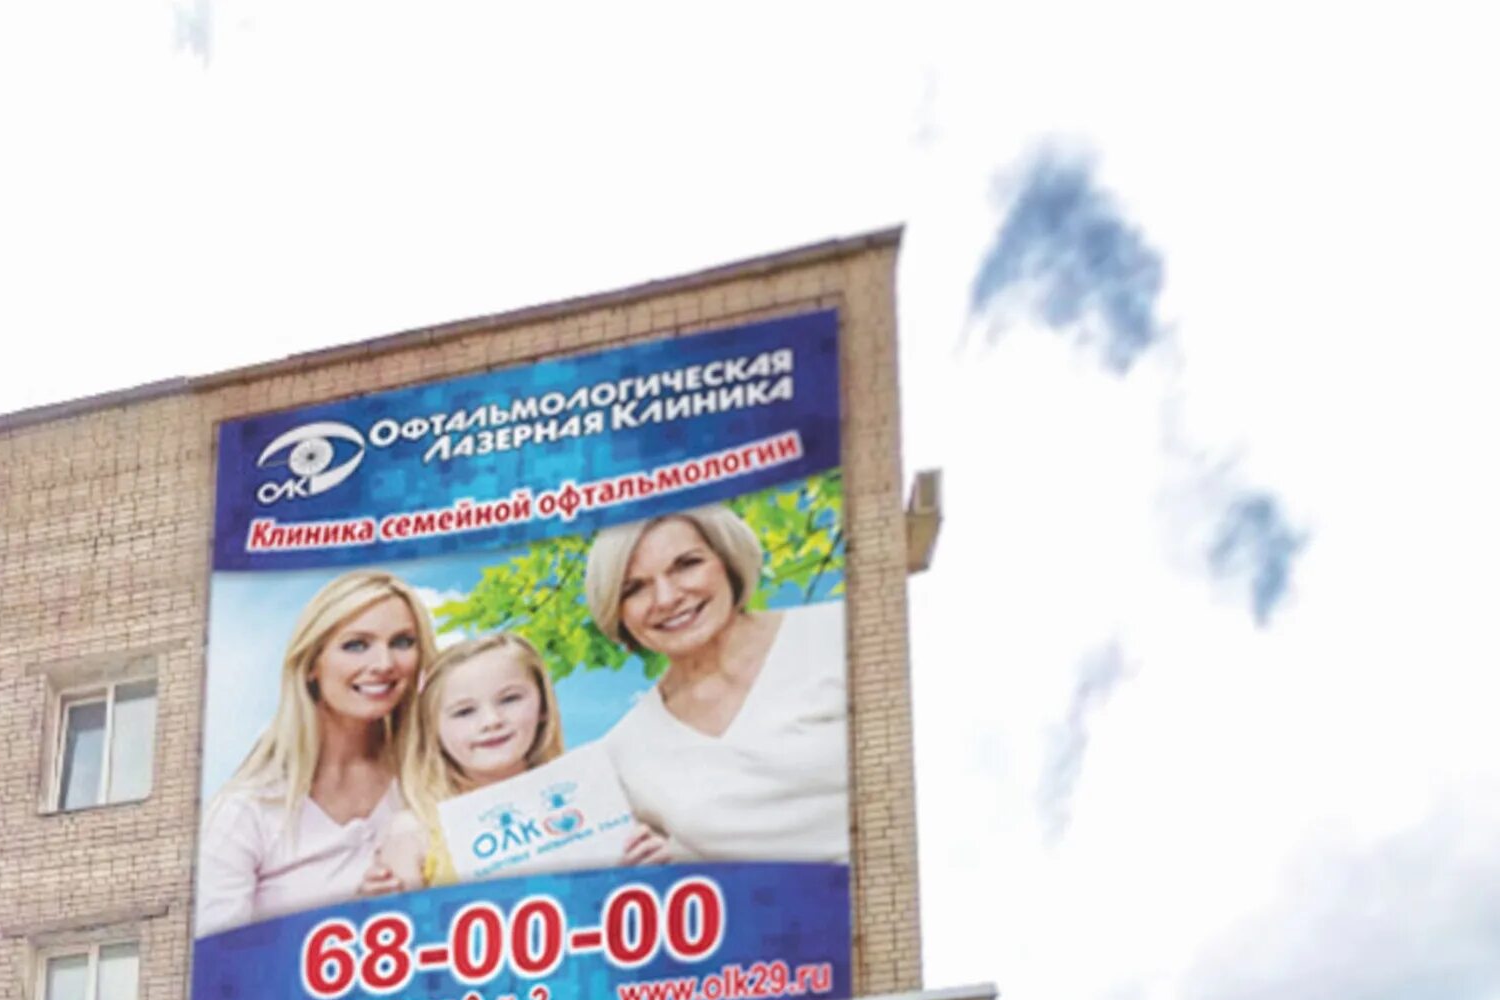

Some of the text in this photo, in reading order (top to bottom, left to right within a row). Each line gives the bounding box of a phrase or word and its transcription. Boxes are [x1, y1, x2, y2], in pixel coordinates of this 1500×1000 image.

[422, 376, 794, 464] ЛАЗЕРНАЯ КЛИНИКА
[250, 433, 800, 549] Клиника семейной офтальмологии
[303, 878, 723, 997] 68-00-00
